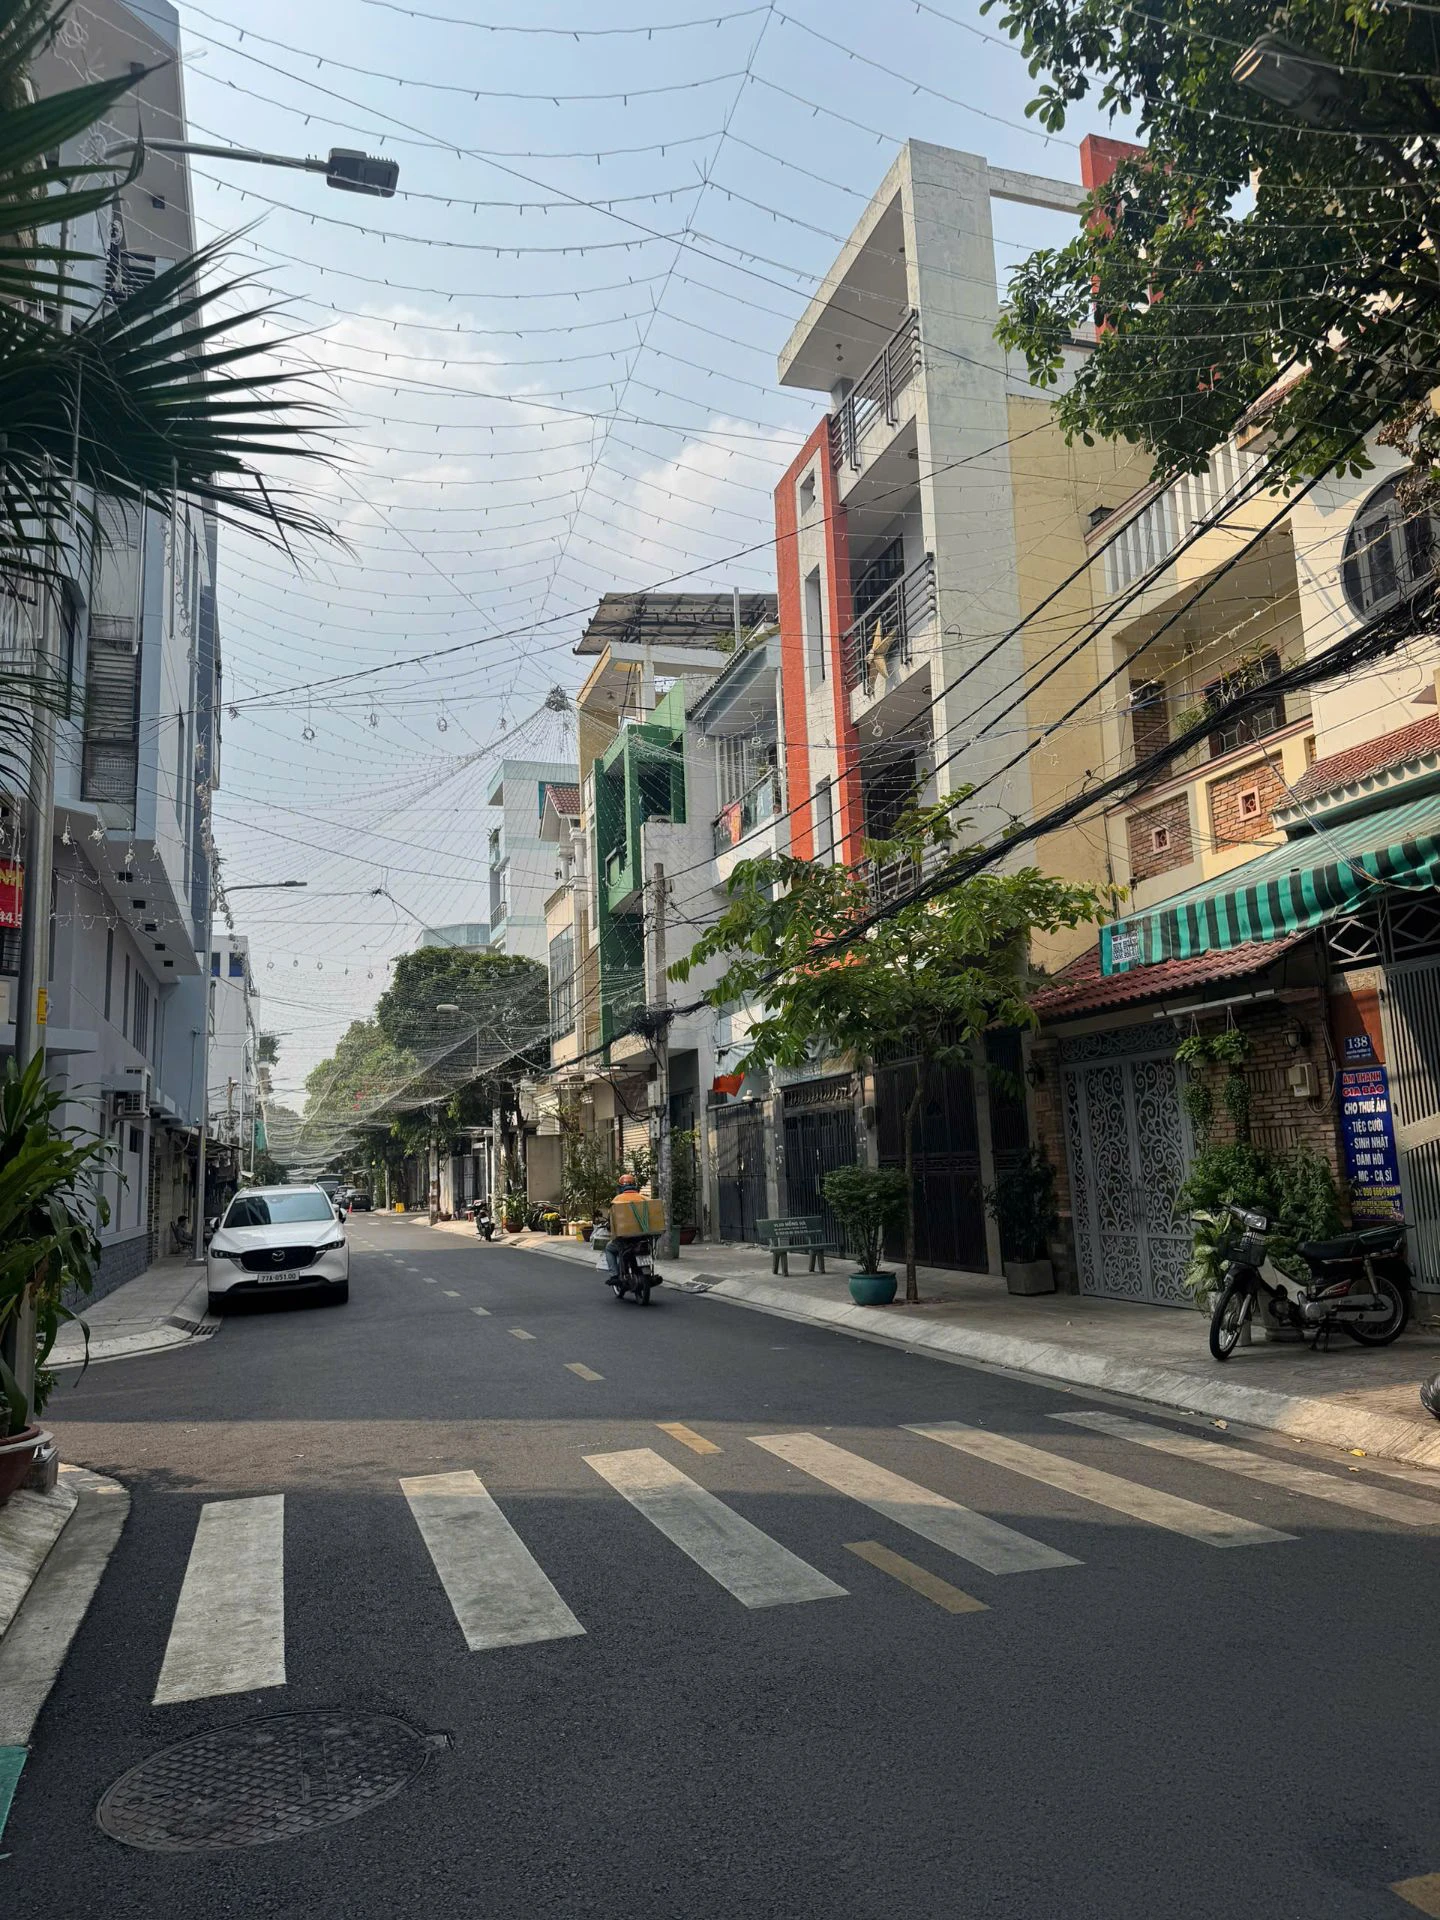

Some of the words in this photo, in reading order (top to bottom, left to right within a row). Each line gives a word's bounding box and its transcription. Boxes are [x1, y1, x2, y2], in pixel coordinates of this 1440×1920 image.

[1347, 1036, 1368, 1049] 138
[1356, 1071, 1382, 1083] THANH
[1343, 1087, 1361, 1097] GIA
[1344, 1102, 1358, 1115] CHO
[1359, 1097, 1375, 1114] THUÊ
[1354, 1137, 1370, 1149] SINH
[1371, 1134, 1389, 1151] NHẬT
[1358, 1170, 1369, 1182] MC
